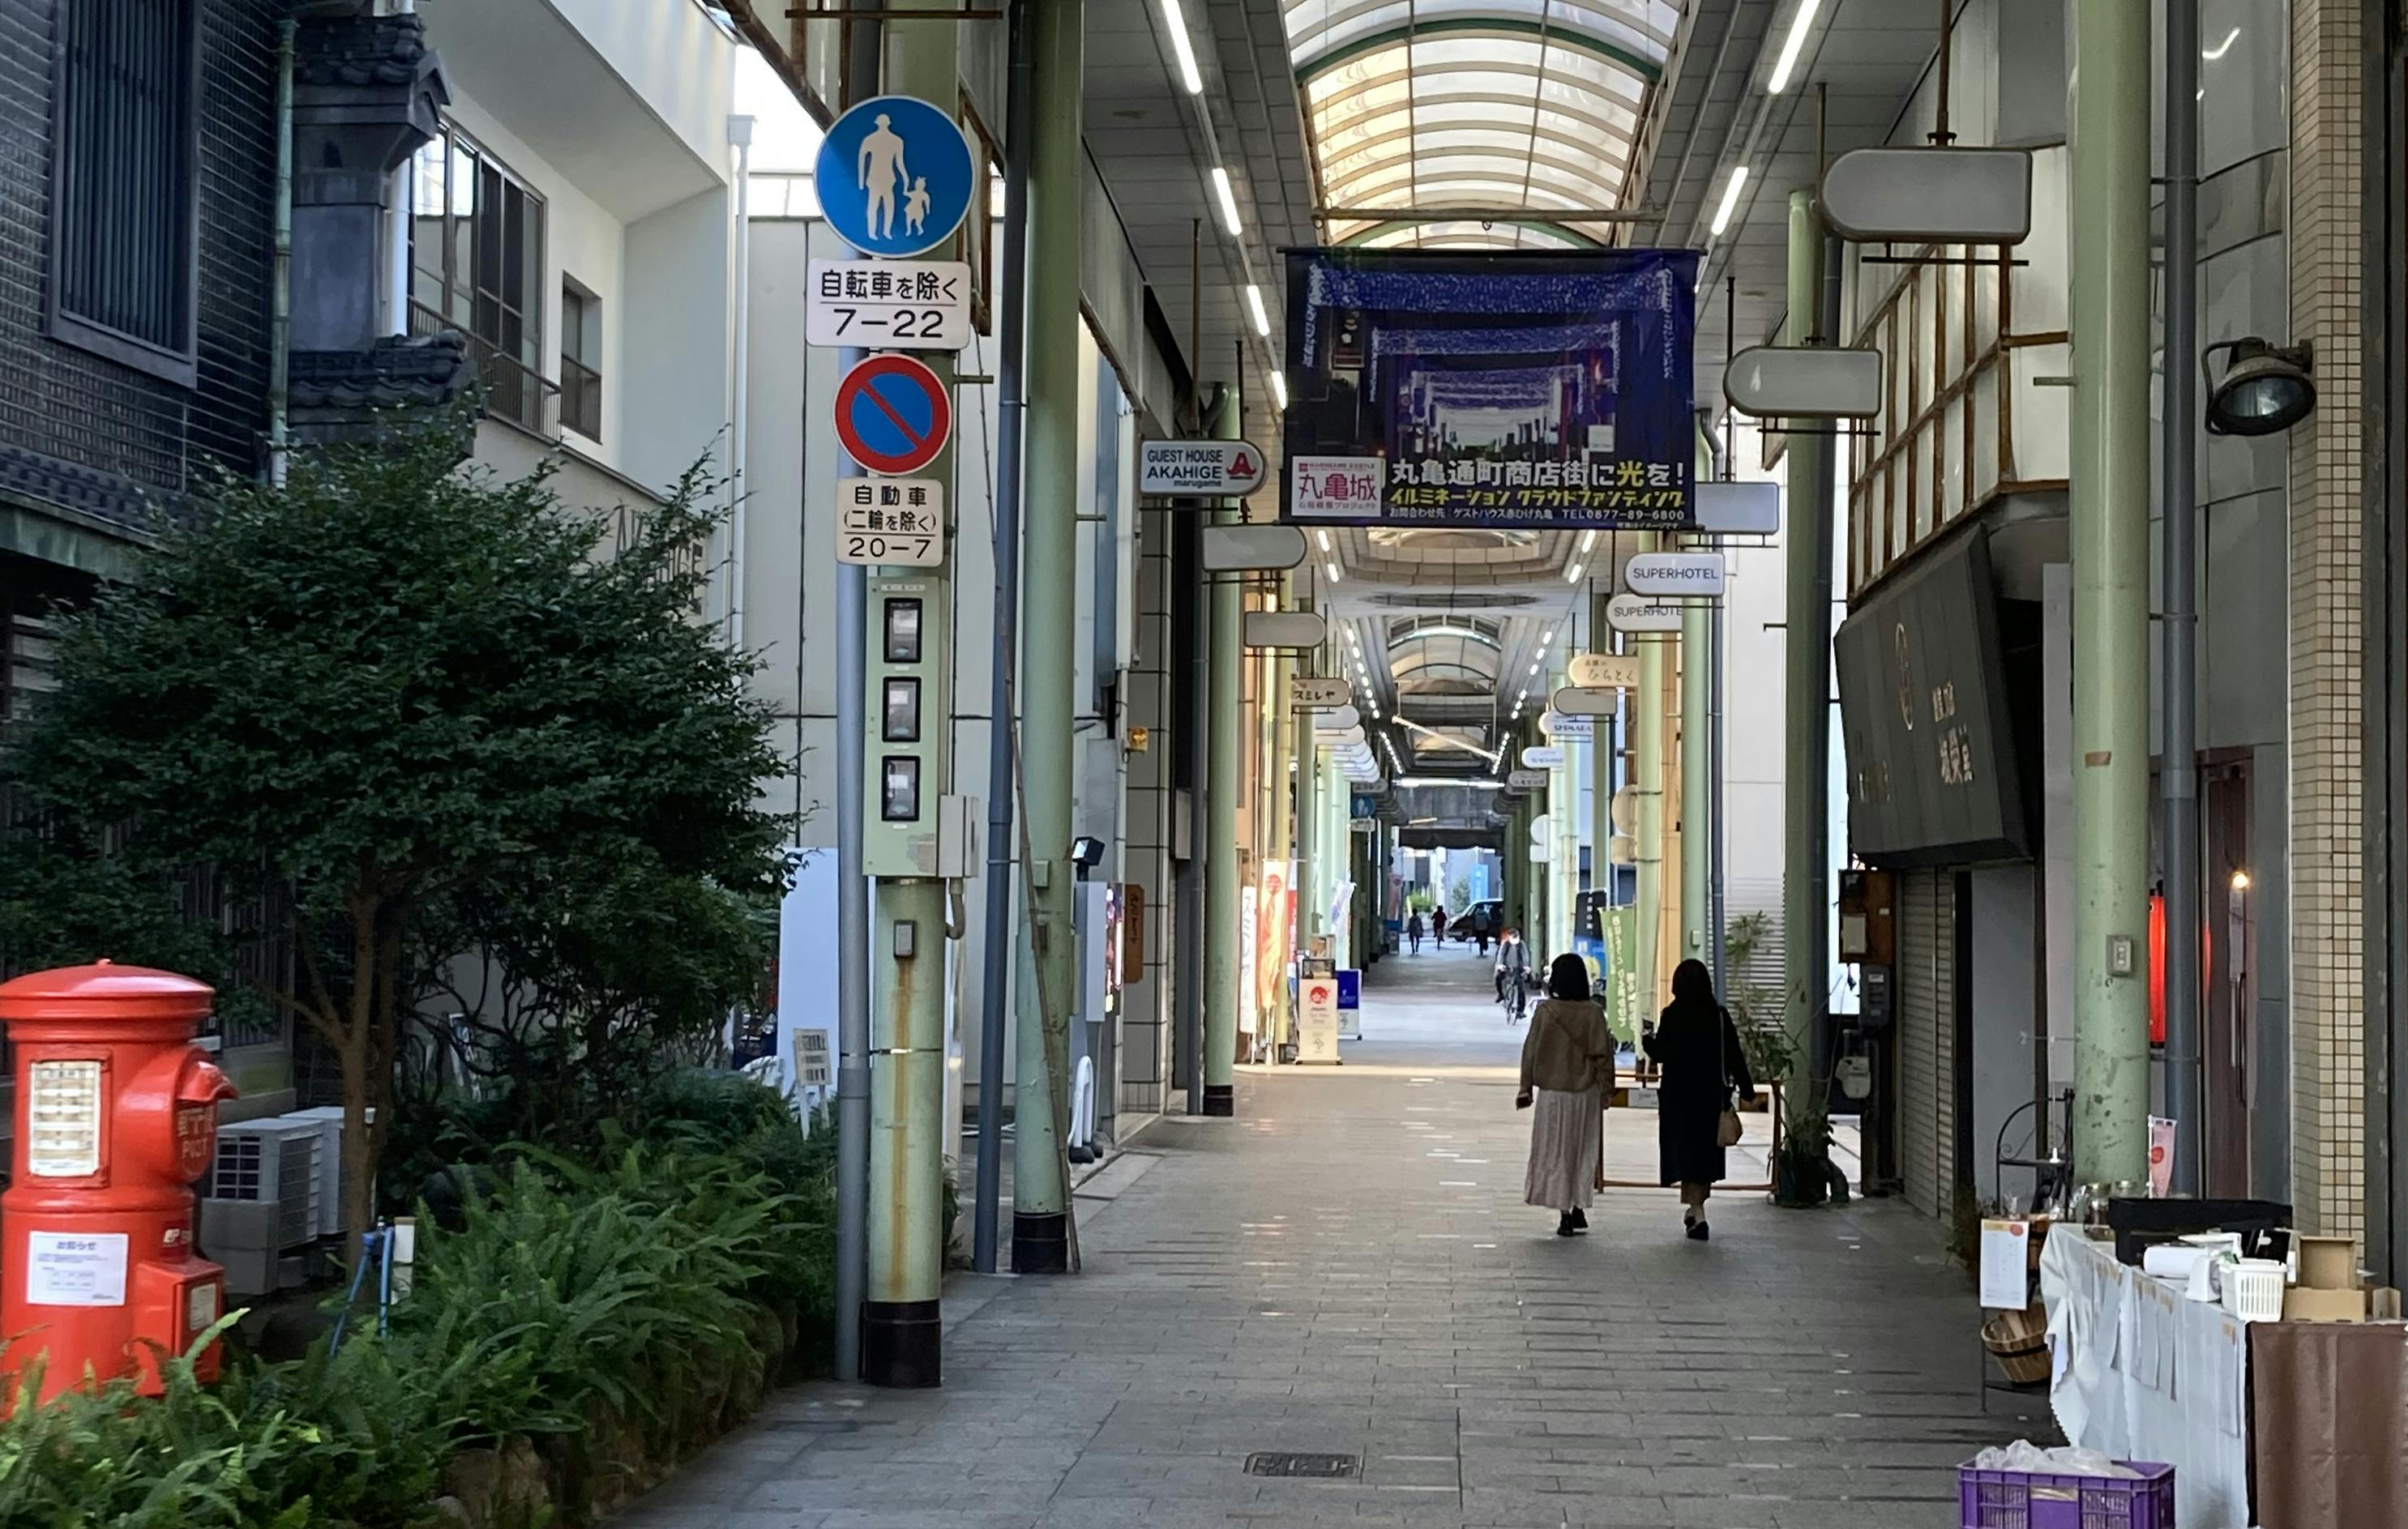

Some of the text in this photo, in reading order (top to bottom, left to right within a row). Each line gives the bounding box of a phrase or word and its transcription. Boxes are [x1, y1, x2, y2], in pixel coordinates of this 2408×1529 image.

[821, 269, 957, 301] 自転車を除く
[1147, 449, 1223, 463] GUEST HOUSE
[1147, 466, 1222, 479] AKAHIGE
[1174, 480, 1222, 489] marugame
[1298, 473, 1378, 501] 丸亀城
[854, 486, 926, 507] 自動車
[1390, 488, 1685, 507] イルミネーション クラウドファンディング
[844, 510, 936, 532] (二輪を除く)
[1633, 567, 1718, 580] SUPERHOTEL
